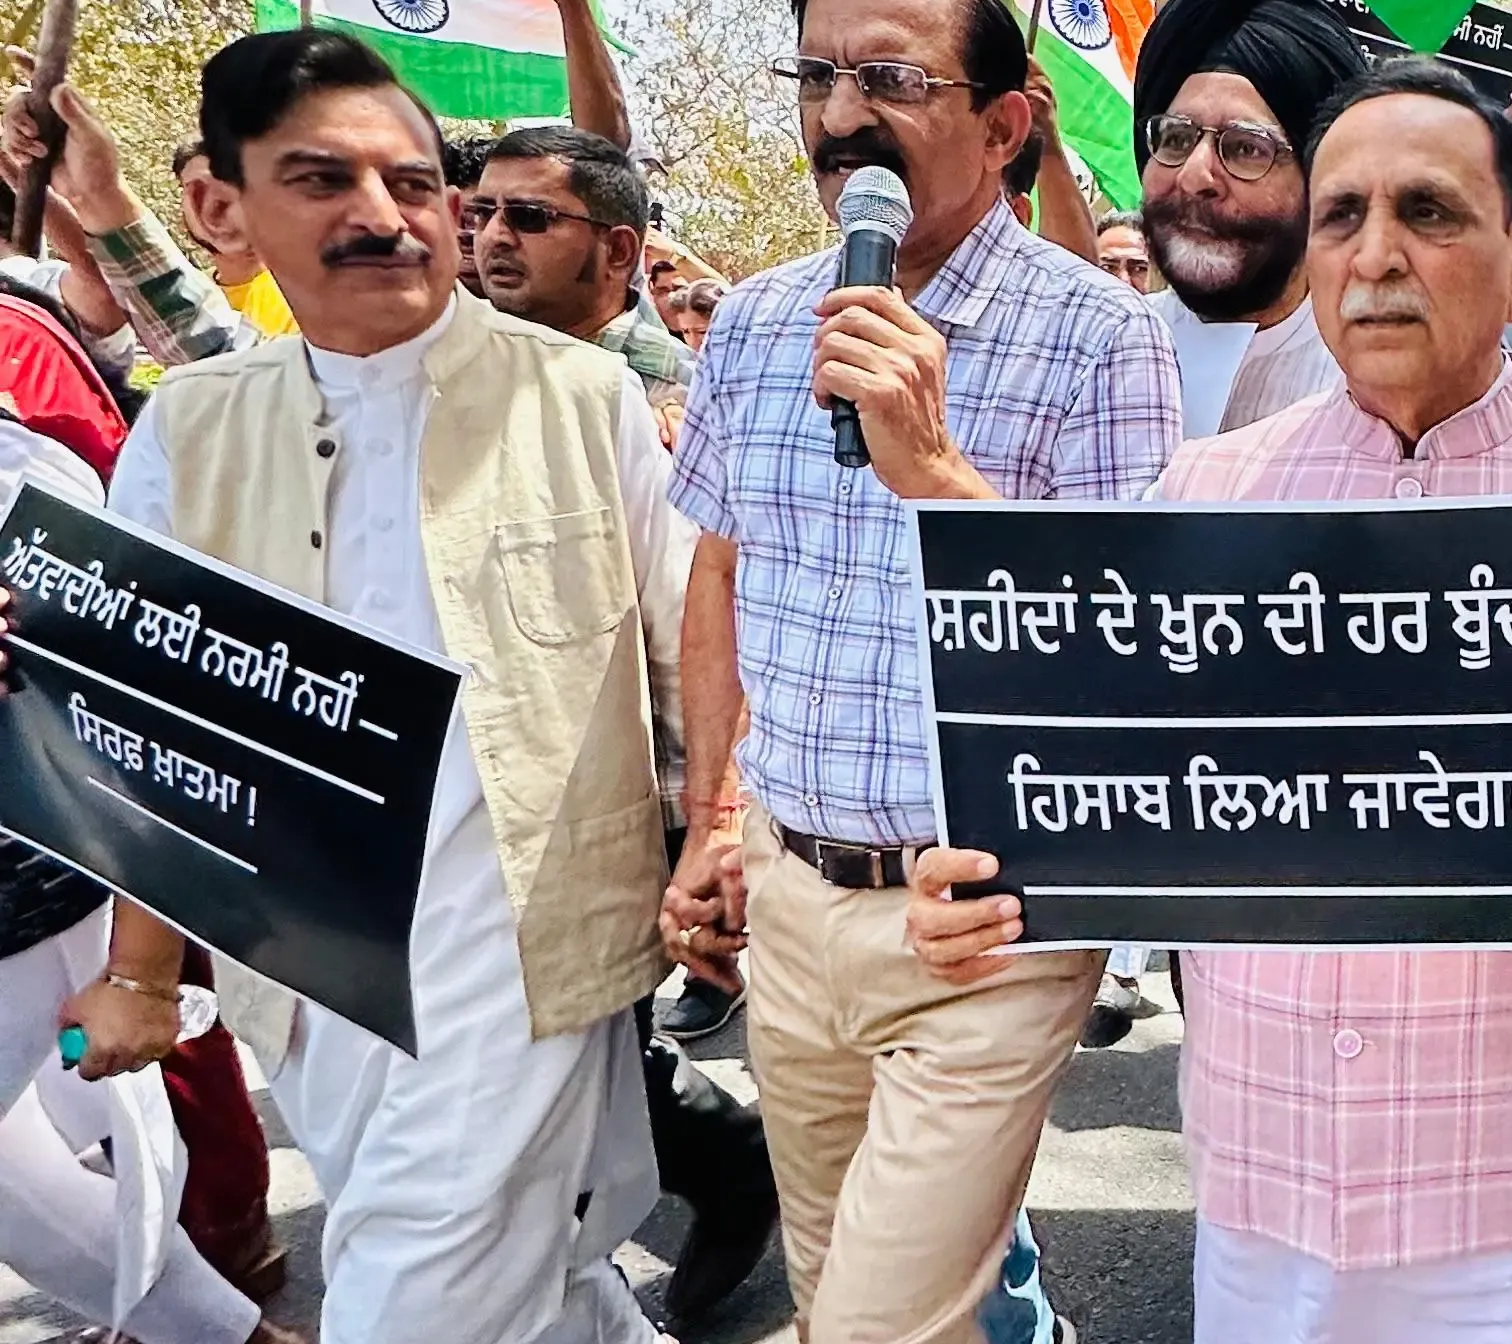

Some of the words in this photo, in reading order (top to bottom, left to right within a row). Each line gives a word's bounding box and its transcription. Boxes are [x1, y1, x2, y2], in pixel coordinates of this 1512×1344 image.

[3, 527, 138, 630] ਅੱਤਵਾਦੀਆਂ
[134, 598, 202, 664] ਲਈ
[201, 627, 290, 702] ਨਰਮੀ
[291, 666, 366, 733] ਨਹੀਂ
[924, 567, 1079, 655] ਸ਼ਹੀਦਾਂ
[1090, 568, 1138, 656] ਦੇ
[1257, 571, 1326, 655] ਦੀ
[1339, 591, 1431, 654] ਹਰ
[67, 691, 145, 772] ਸਿਰਫ਼
[1007, 753, 1171, 832] ਹਿਸਾਬ
[1182, 754, 1330, 832] ਲਿਆ
